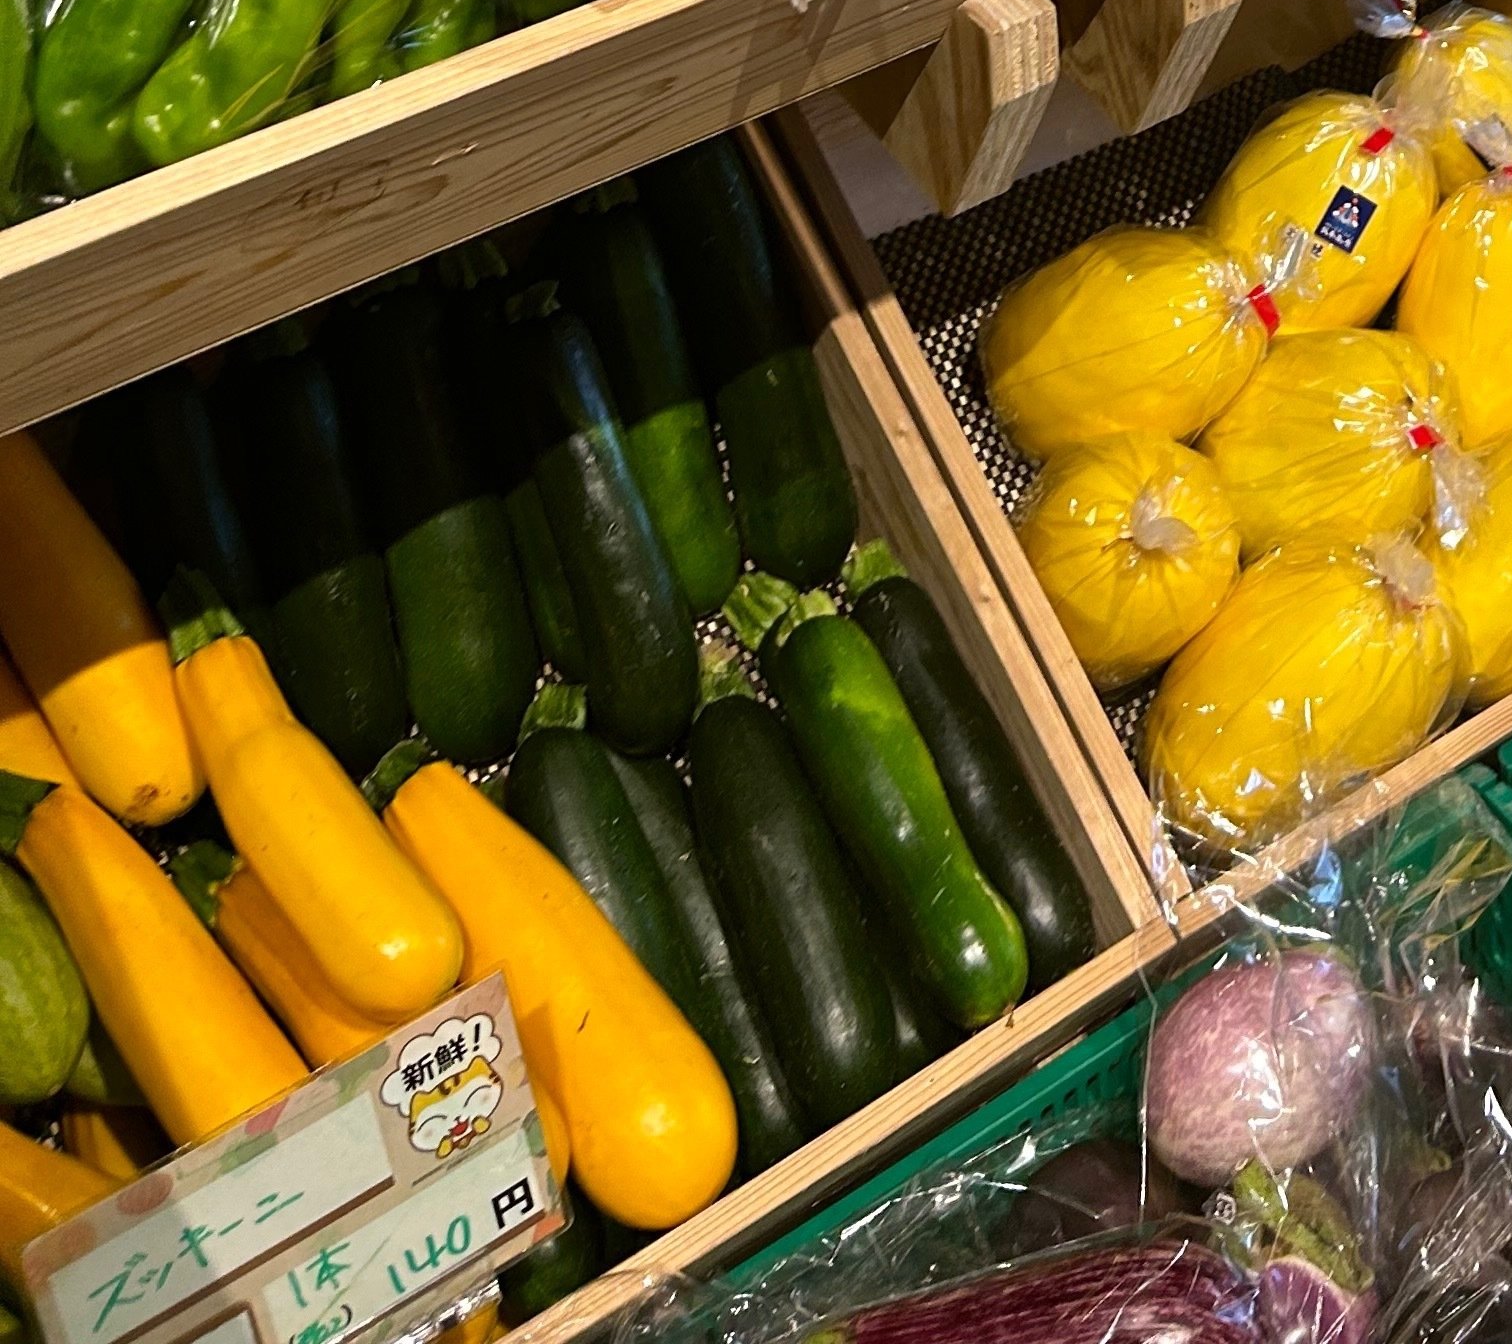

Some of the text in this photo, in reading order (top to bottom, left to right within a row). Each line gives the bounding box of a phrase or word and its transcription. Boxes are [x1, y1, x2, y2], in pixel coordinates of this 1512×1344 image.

[401, 1022, 483, 1094] 新鮮!
[88, 1191, 305, 1334] ズッキーニ
[385, 1214, 474, 1296] 140
[491, 1176, 536, 1230] 円
